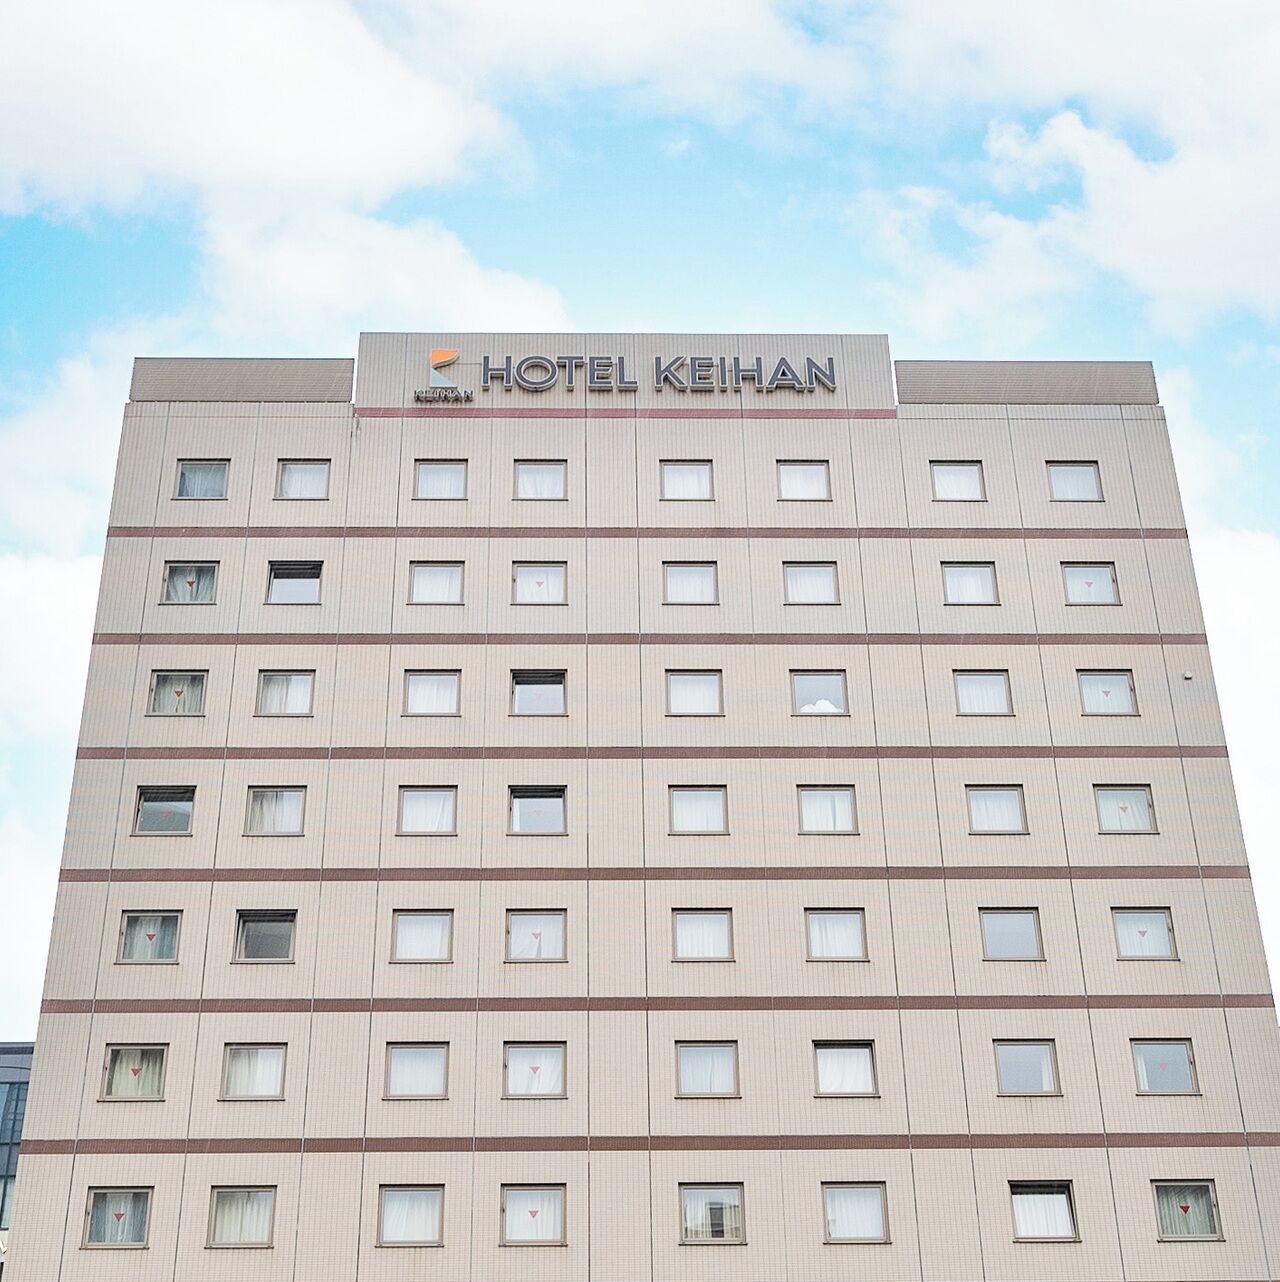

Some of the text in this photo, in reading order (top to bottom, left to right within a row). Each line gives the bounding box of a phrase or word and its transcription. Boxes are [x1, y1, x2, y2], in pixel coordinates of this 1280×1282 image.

[481, 355, 837, 392] HOTEL KEIHAN
[413, 388, 475, 403] KEIHAN
